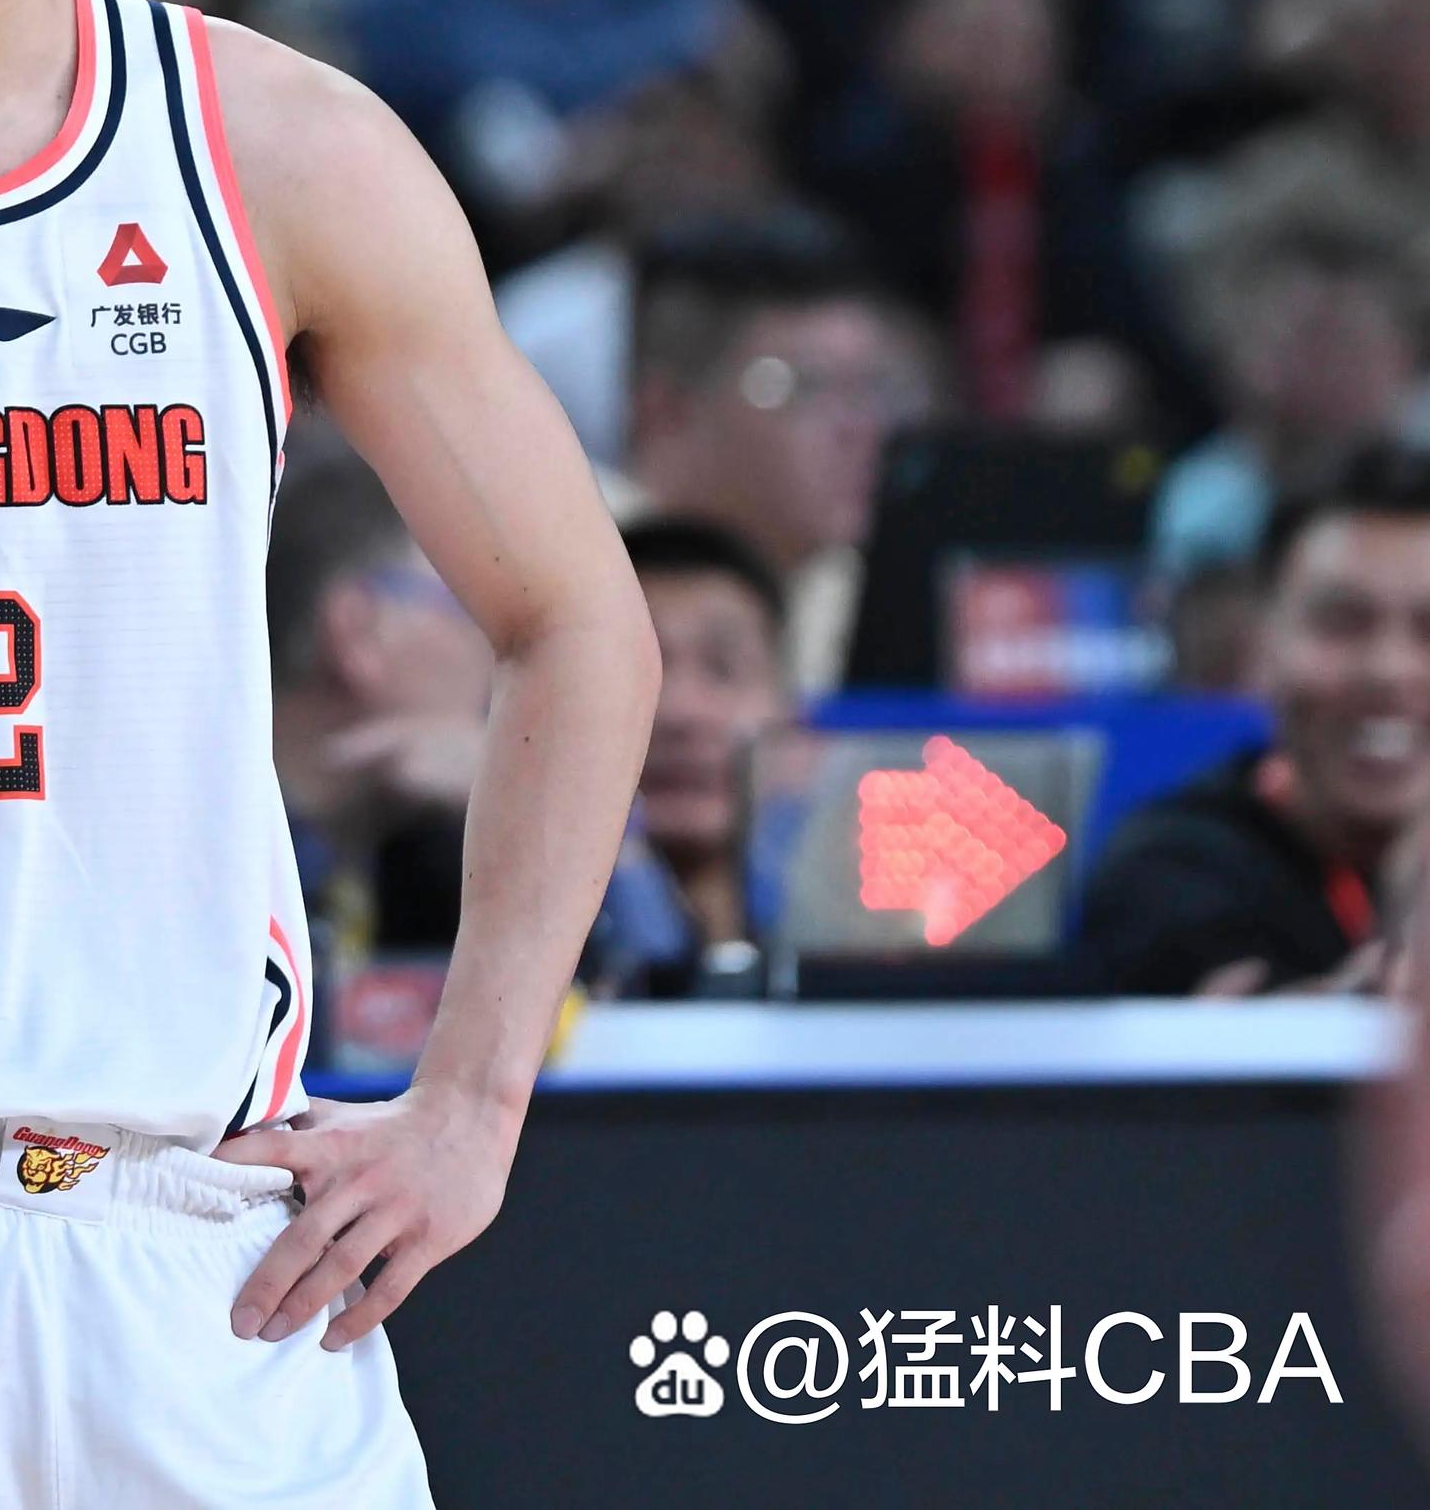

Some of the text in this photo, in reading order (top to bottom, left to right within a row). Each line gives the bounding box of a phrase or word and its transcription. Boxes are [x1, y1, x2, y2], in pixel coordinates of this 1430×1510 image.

[91, 302, 182, 328] 广发银行
[110, 331, 167, 356] CGB
